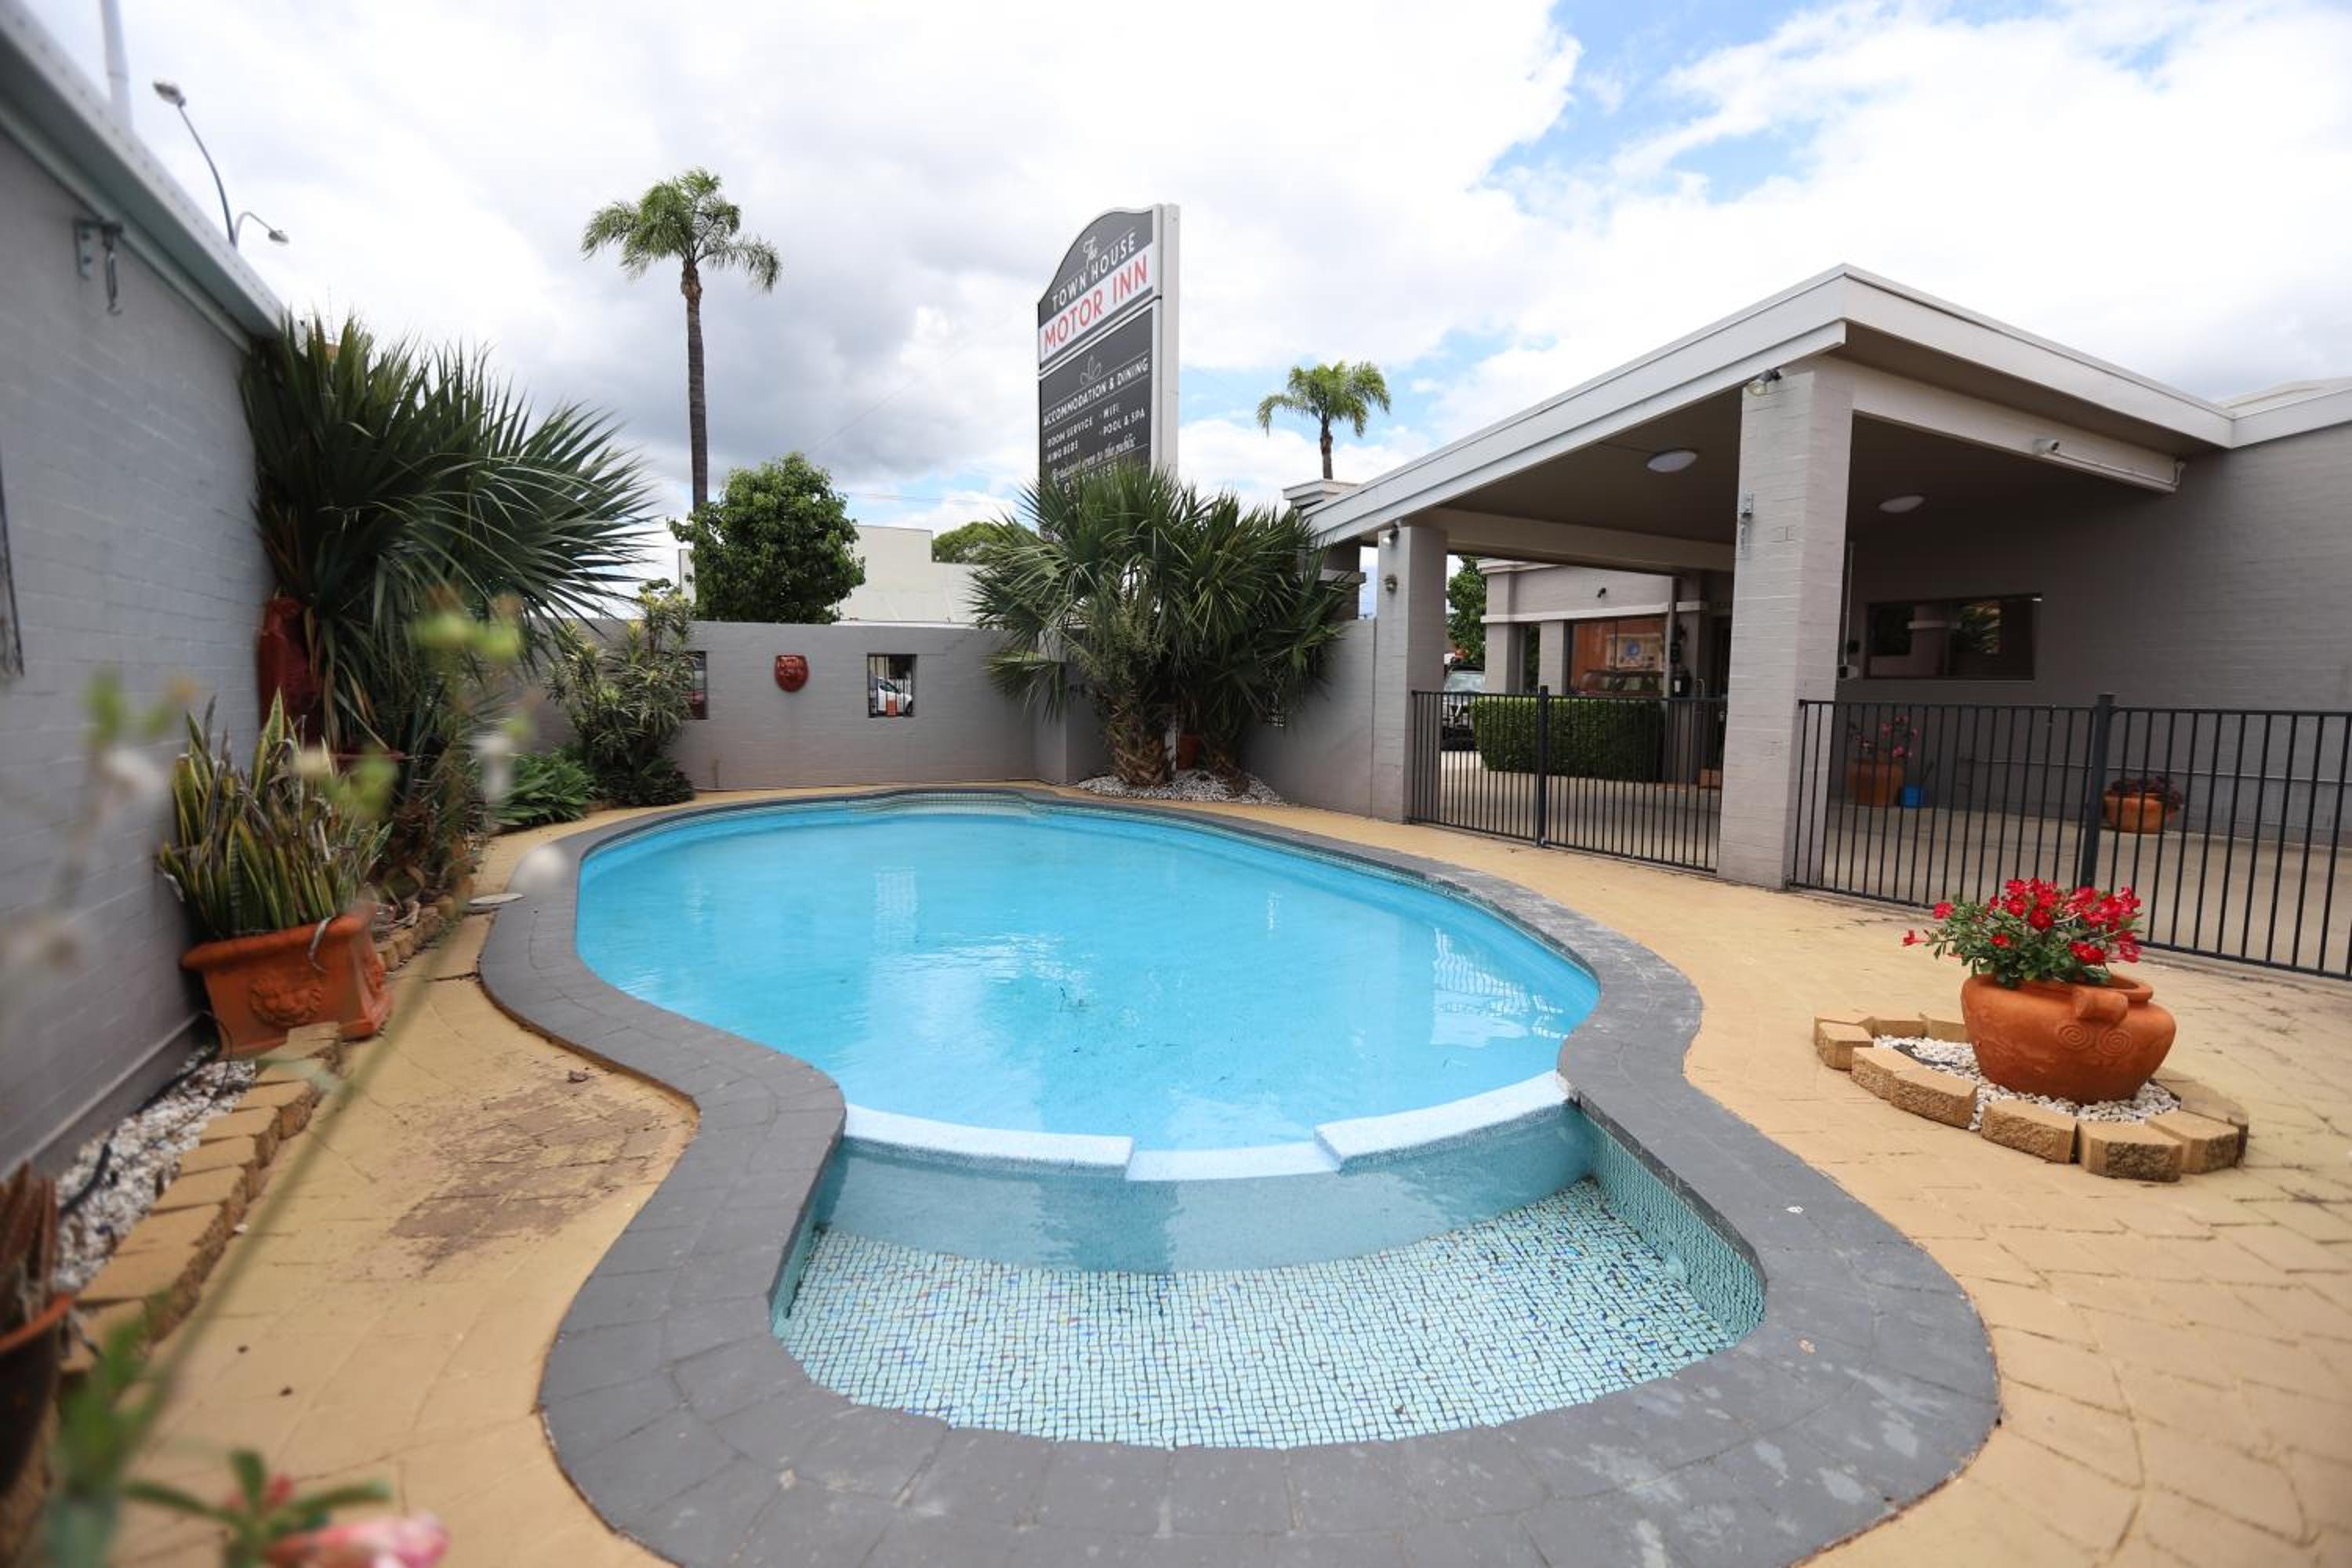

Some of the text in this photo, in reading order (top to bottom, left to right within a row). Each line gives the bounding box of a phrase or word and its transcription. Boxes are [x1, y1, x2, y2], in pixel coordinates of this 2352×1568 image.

[1044, 252, 1148, 354] MOTOR INN
[1052, 232, 1136, 311] TOWN HOUSE
[1044, 381, 1106, 426] ACCOMMODATION
[1117, 358, 1149, 387] DINING
[1103, 419, 1122, 436] POOL
[1131, 407, 1145, 424] SPA
[1065, 416, 1092, 438] SERVICE
